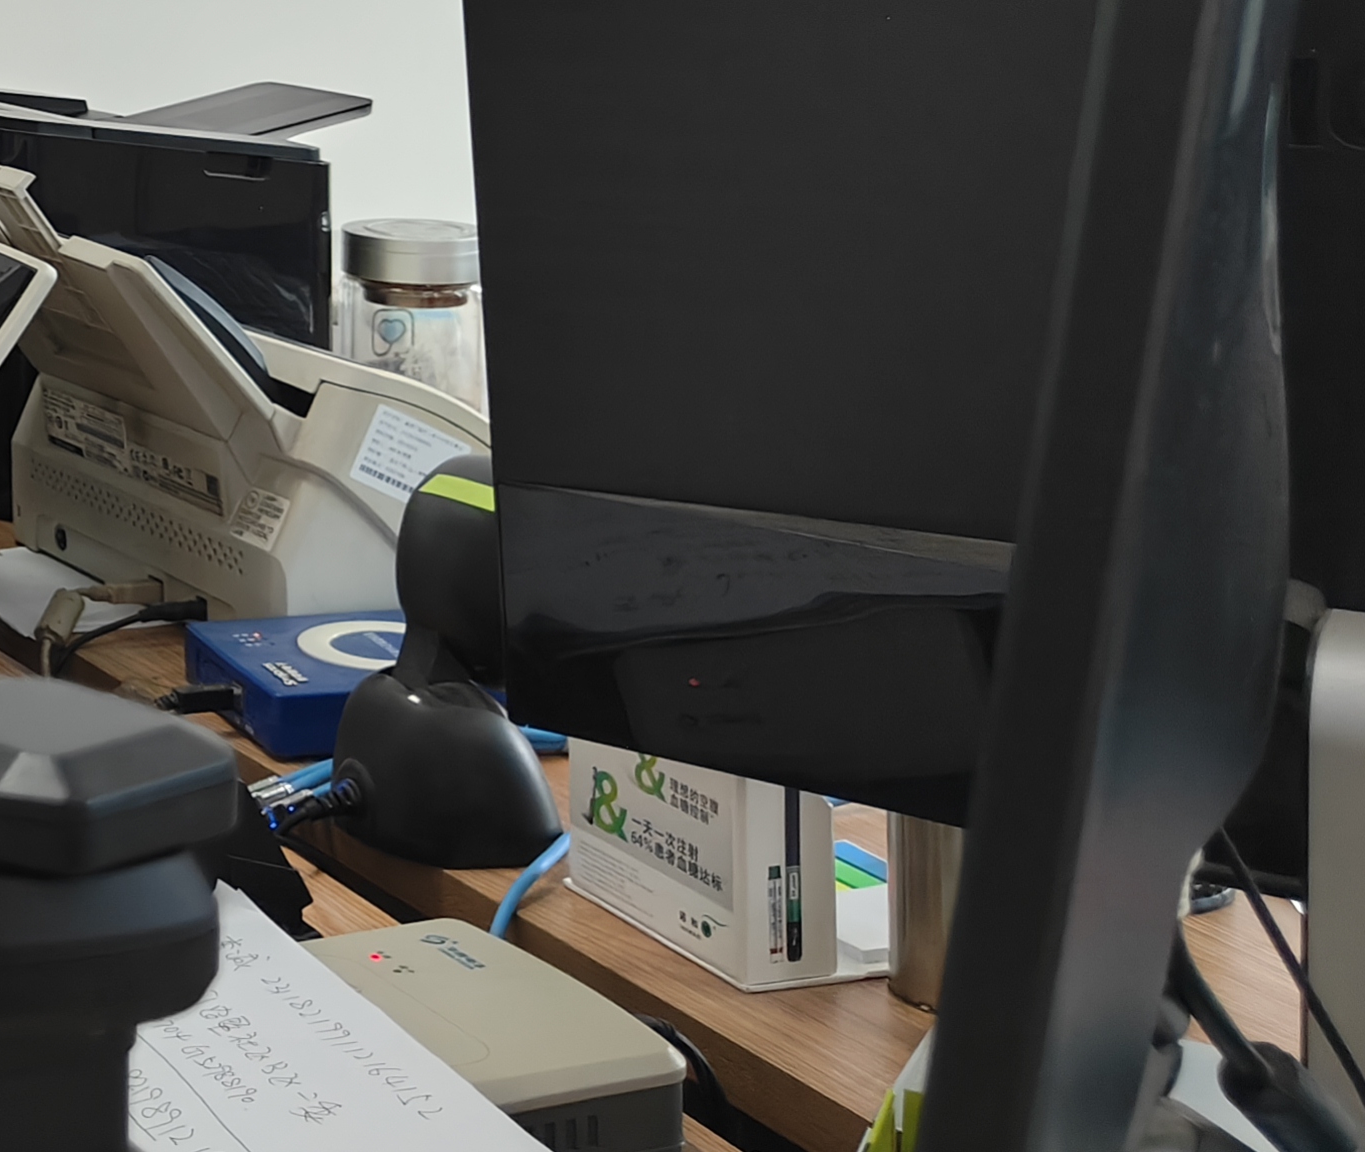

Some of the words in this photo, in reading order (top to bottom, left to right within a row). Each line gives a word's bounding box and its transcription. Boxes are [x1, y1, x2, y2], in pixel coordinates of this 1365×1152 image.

[630, 816, 699, 862] 一天一次注射
[630, 830, 723, 892] 64%患者血糖达标
